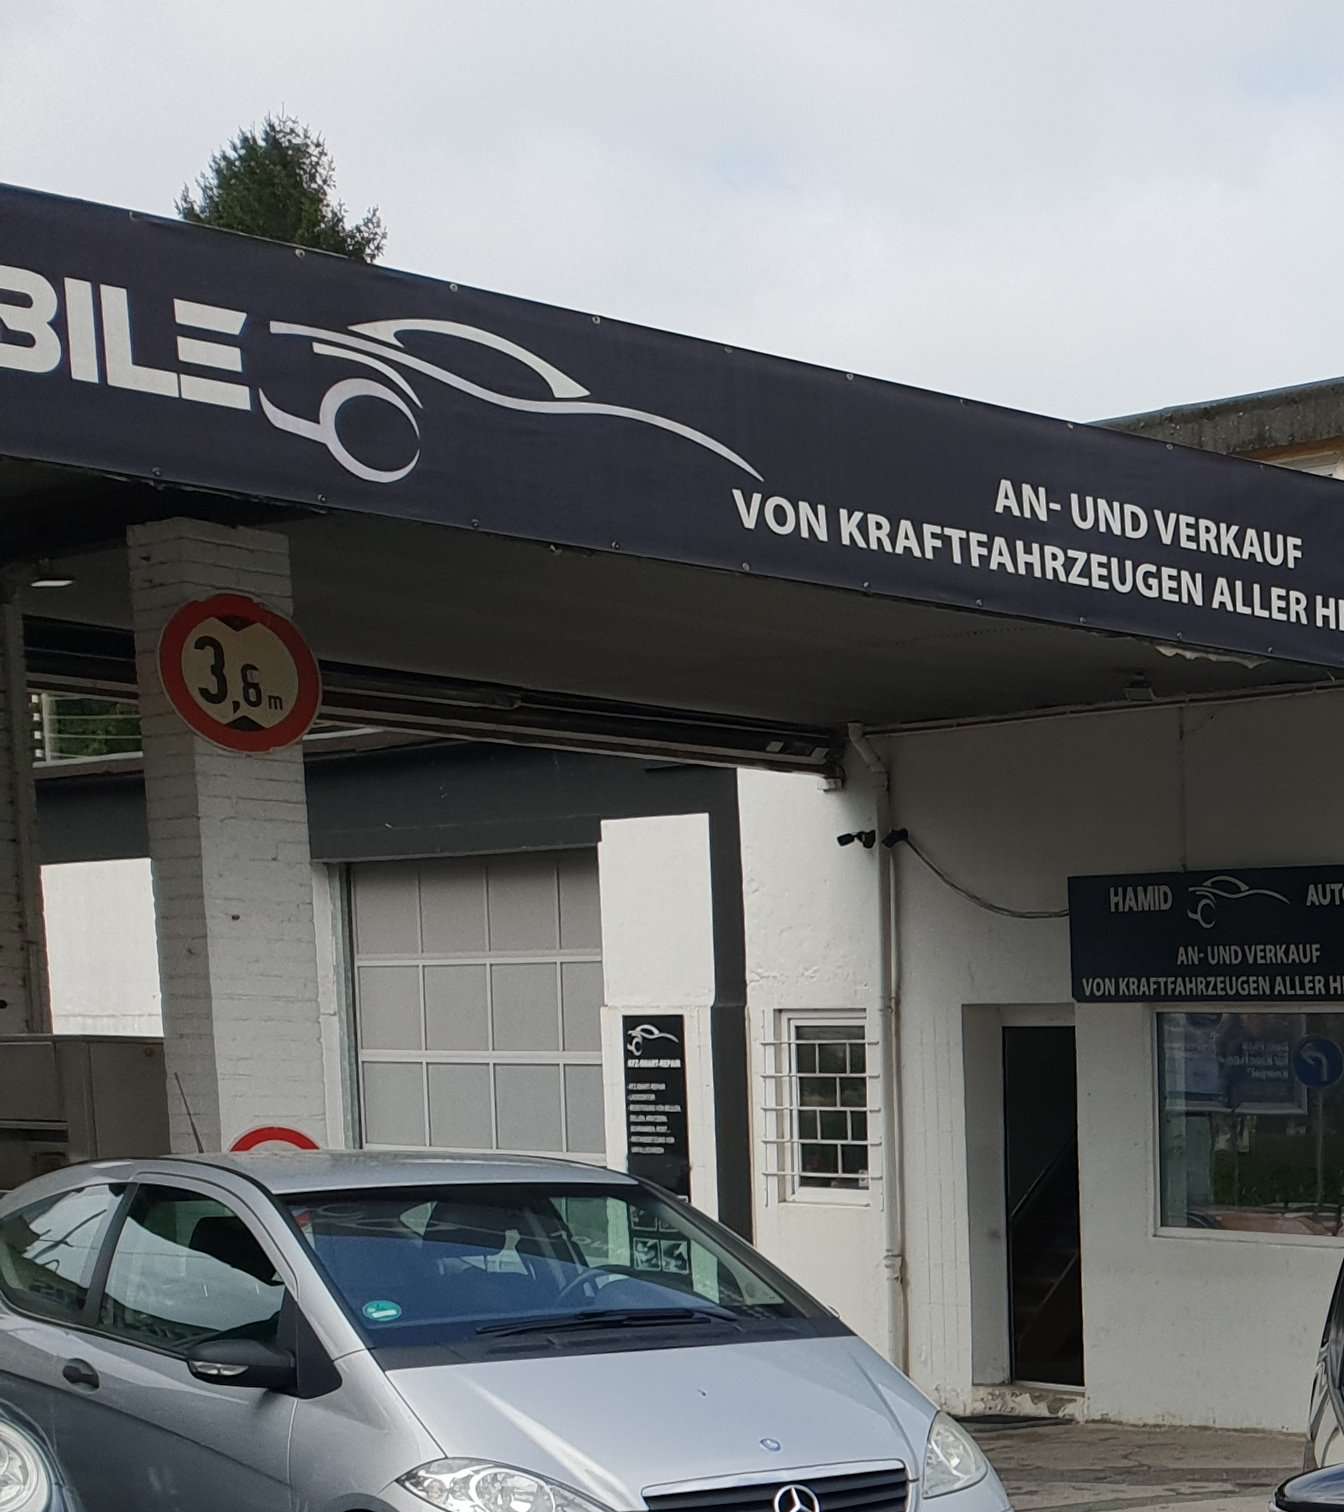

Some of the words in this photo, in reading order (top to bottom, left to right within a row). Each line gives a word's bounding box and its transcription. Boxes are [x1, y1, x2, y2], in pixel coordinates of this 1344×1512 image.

[994, 479, 1061, 522] AN-
[1070, 493, 1149, 540] UND
[1153, 509, 1303, 569] VERKAUF
[732, 488, 828, 542] VON
[839, 508, 1203, 607] KRAFTFAHRZEUGEN
[1211, 577, 1308, 625] ALLER
[1110, 886, 1173, 912] HAMID
[1177, 946, 1205, 965] AN-
[1208, 946, 1242, 964] UND
[1246, 944, 1321, 964] VERKAUF
[1082, 978, 1115, 997] VON
[1119, 976, 1270, 996] KRAFTFAHRZEUGEN
[1274, 975, 1325, 995] ALLER
